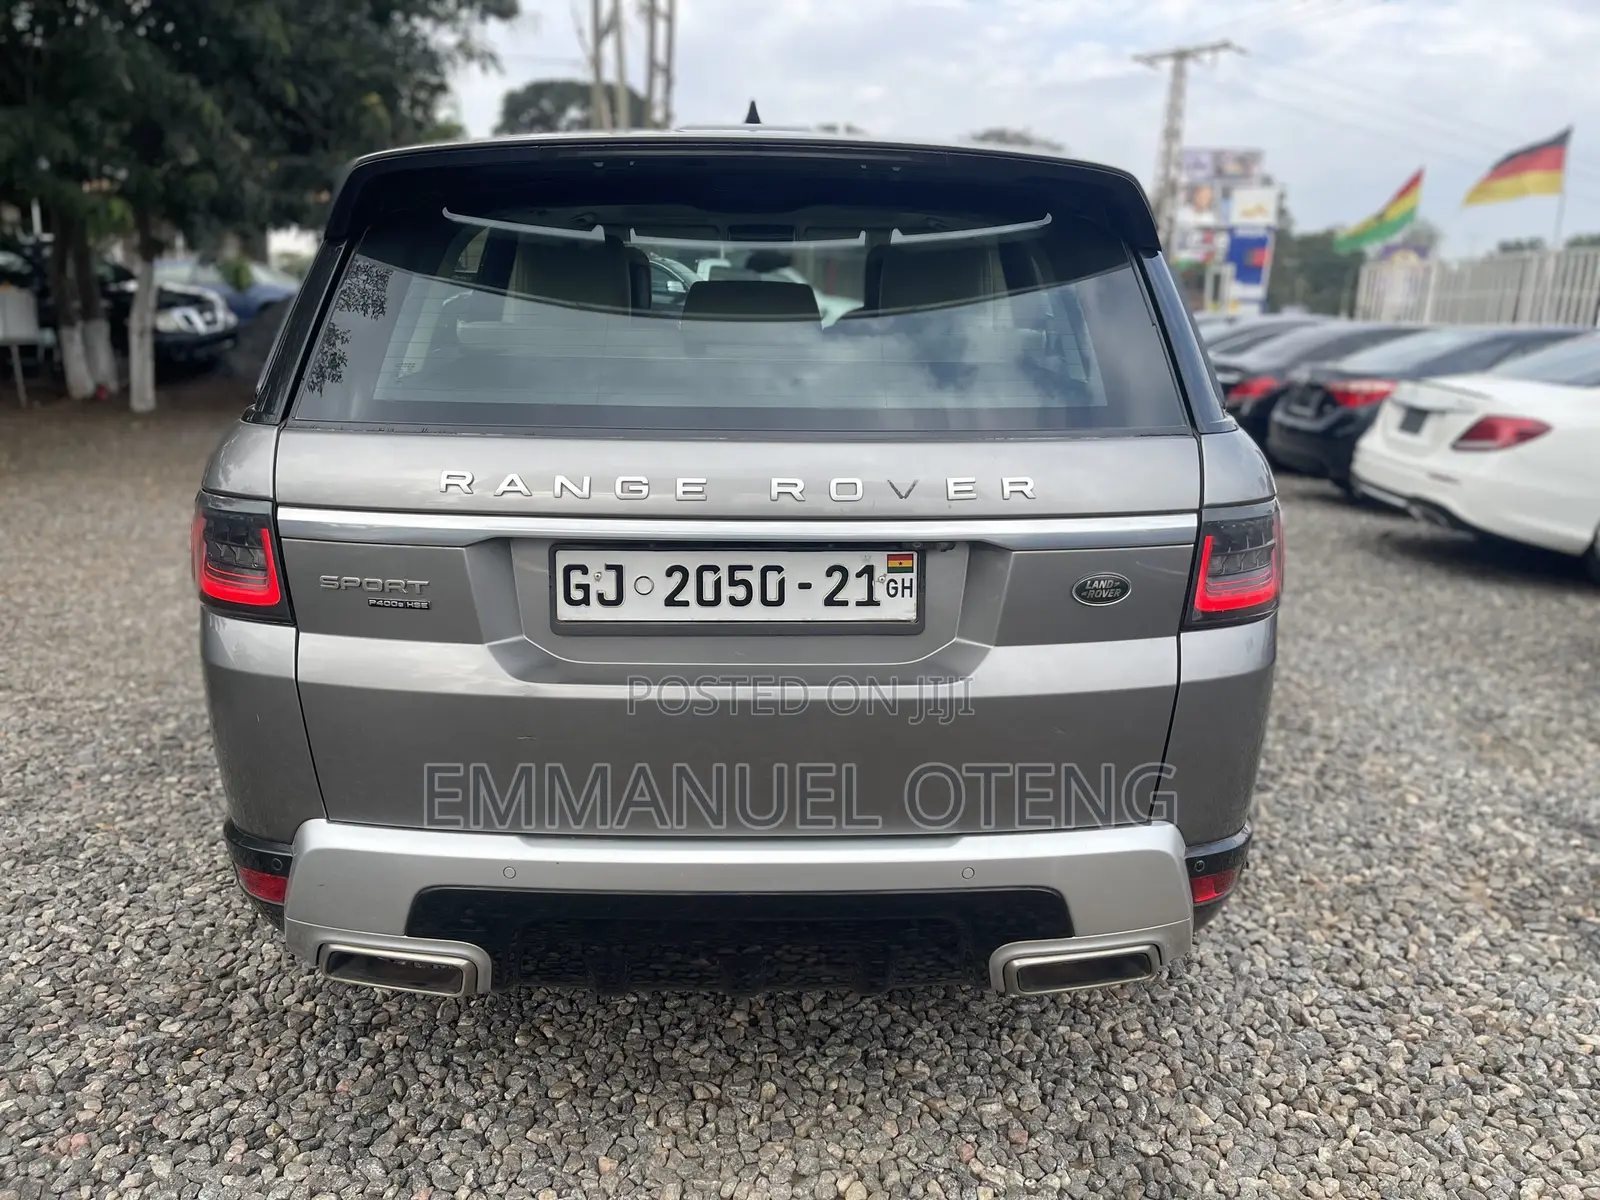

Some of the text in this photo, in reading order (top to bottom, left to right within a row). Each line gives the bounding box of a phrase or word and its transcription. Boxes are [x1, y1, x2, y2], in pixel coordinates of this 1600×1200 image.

[439, 469, 1037, 502] RANGE ROVER
[319, 575, 430, 594] SPORT
[562, 563, 626, 608] GJ
[885, 577, 914, 599] GH
[1085, 580, 1114, 589] LAND
[1087, 588, 1121, 598] ROVER
[406, 601, 428, 609] HSE
